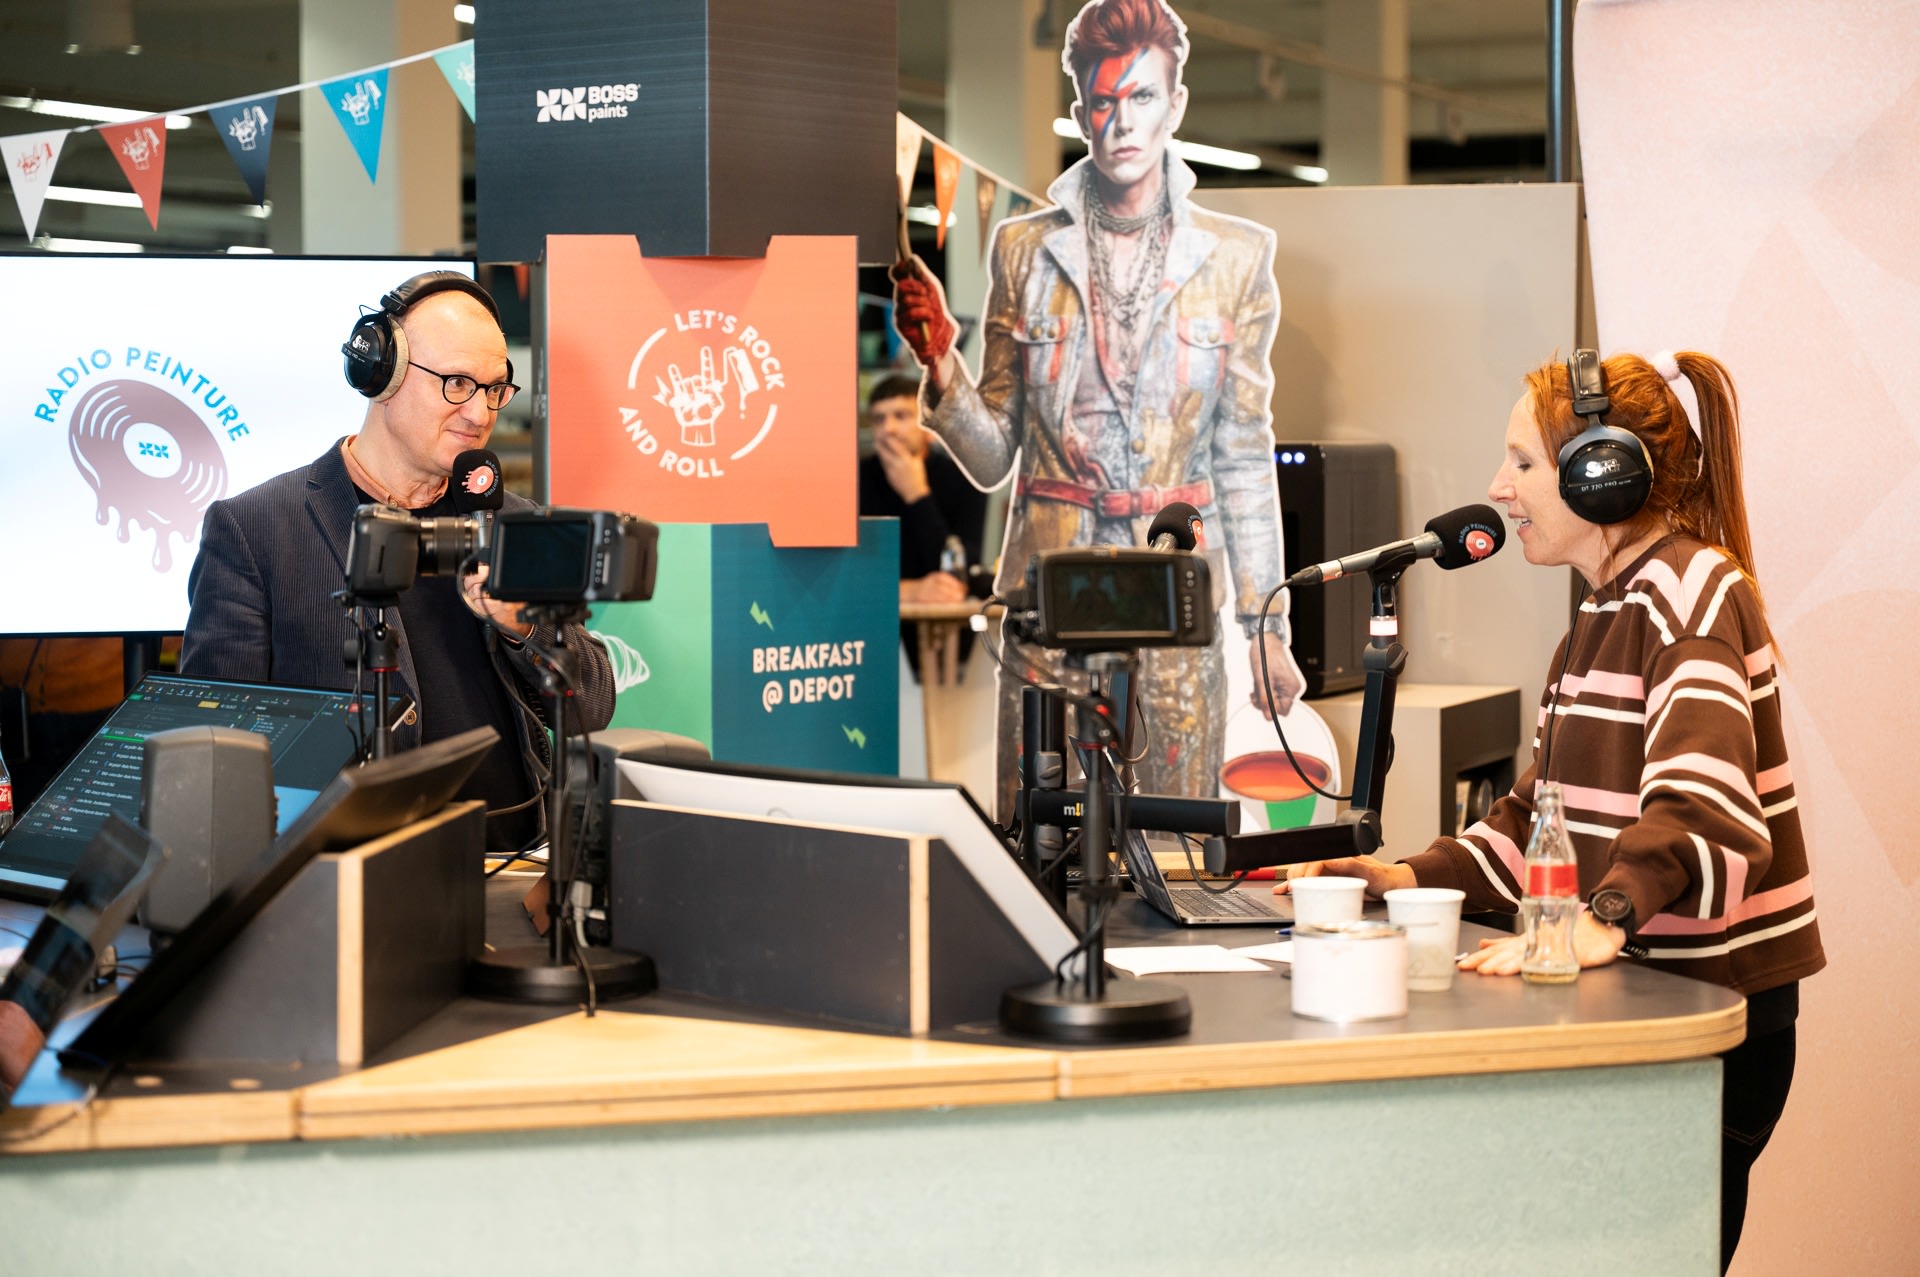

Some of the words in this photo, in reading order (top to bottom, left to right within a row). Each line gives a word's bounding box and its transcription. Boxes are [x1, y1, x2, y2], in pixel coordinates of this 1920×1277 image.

[588, 104, 629, 123] paints
[674, 309, 738, 335] LET'S
[738, 325, 785, 391] ROCK
[34, 349, 112, 423] RADIO
[126, 347, 251, 441] PEINTURE
[618, 407, 658, 455] AND
[659, 449, 724, 478] ROLL
[752, 640, 865, 673] BREAKFAST
[762, 681, 783, 713] @
[789, 674, 855, 704] DEPOT
